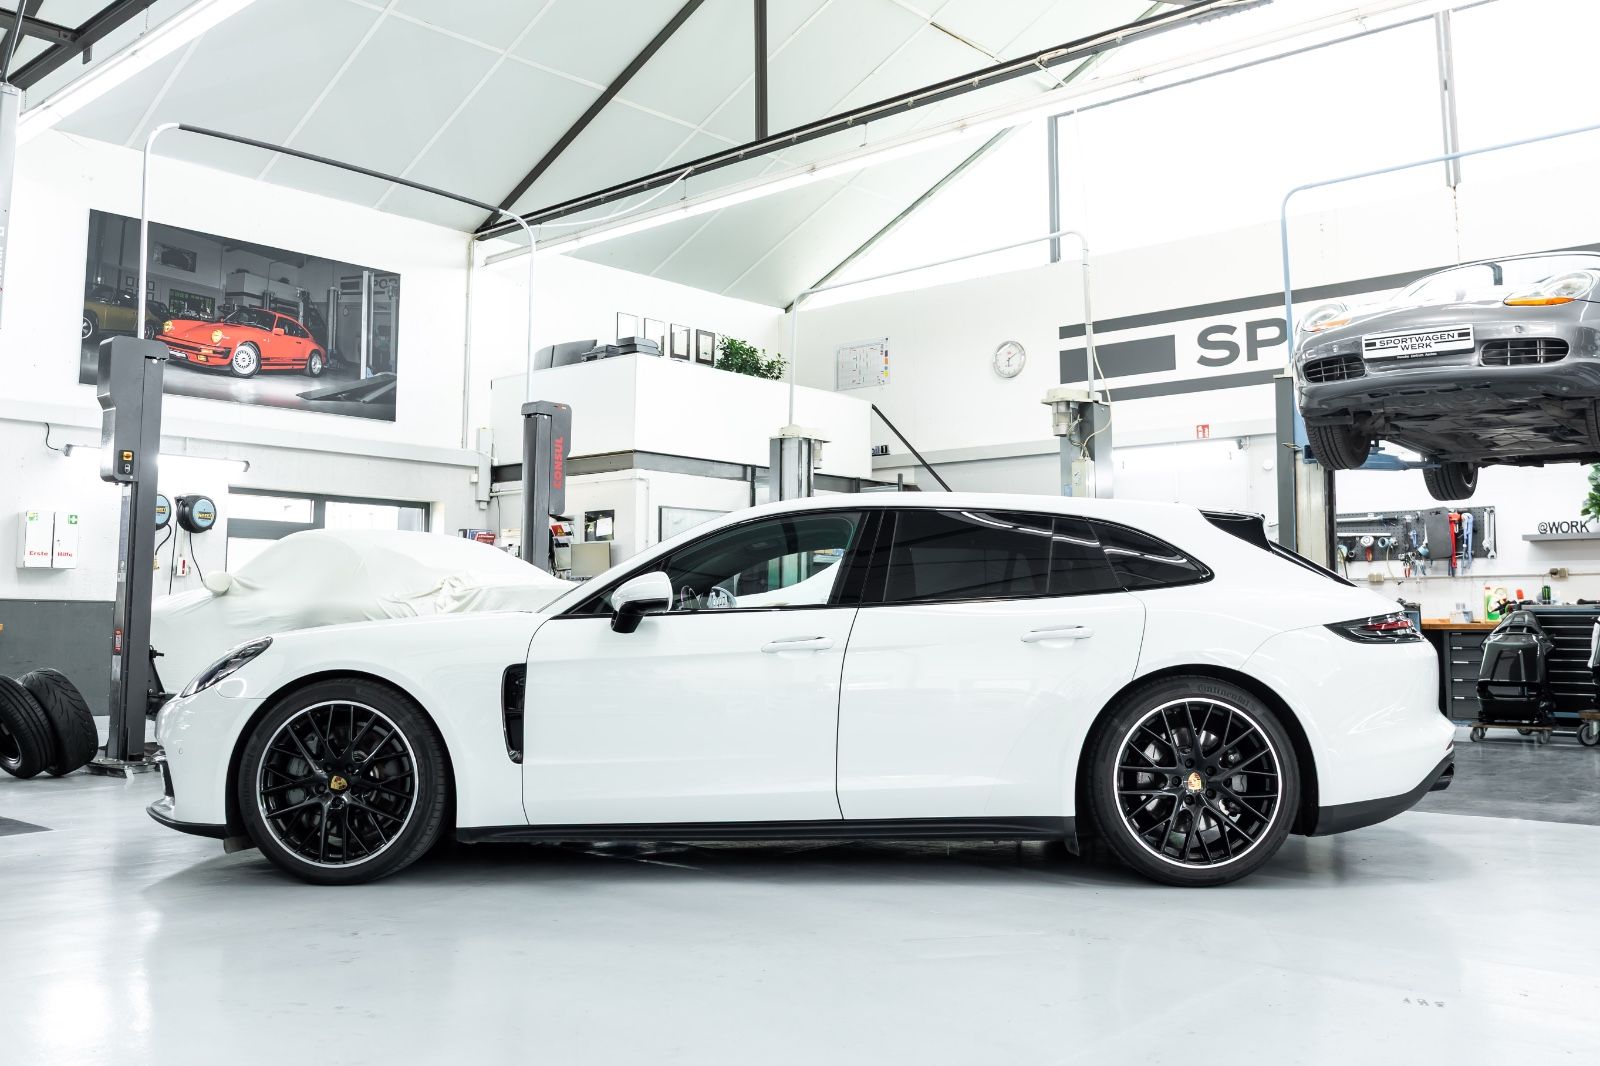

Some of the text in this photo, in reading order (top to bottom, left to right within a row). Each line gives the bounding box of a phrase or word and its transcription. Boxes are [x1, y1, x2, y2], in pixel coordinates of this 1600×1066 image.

[1379, 333, 1455, 347] SPORTWAGEN
[1400, 342, 1433, 351] WERK
[552, 436, 564, 489] CONSUL
[1538, 521, 1589, 534] @WORK
